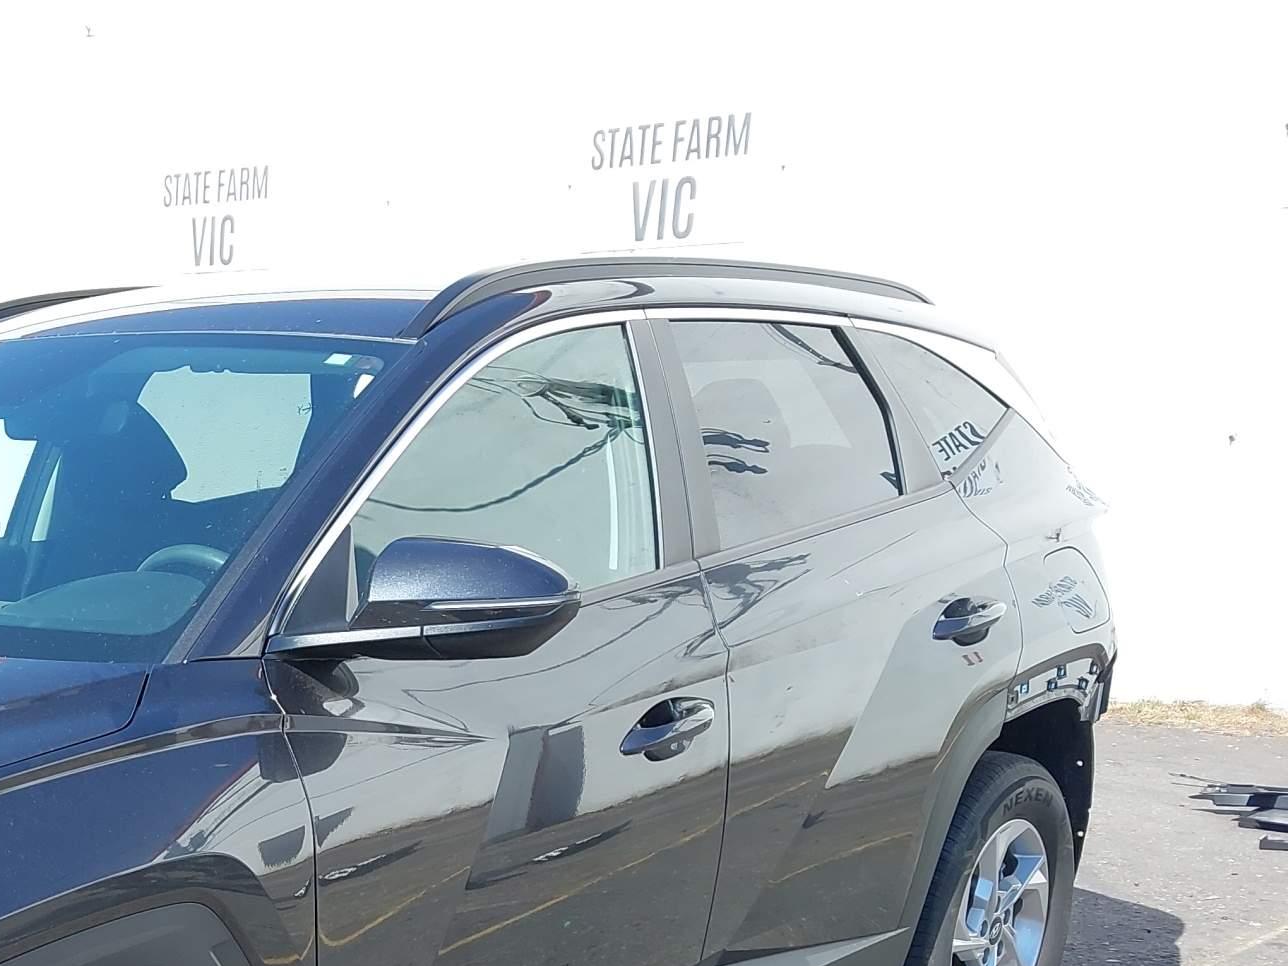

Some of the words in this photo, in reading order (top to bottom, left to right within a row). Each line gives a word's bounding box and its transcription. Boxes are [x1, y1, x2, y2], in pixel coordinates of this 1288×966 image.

[590, 122, 665, 171] STATE
[672, 112, 752, 163] FARM
[163, 170, 212, 208] STATE
[217, 165, 269, 203] FARM
[632, 175, 697, 242] VIC
[192, 214, 235, 267] VIC
[1001, 786, 1054, 817] NEXEN
